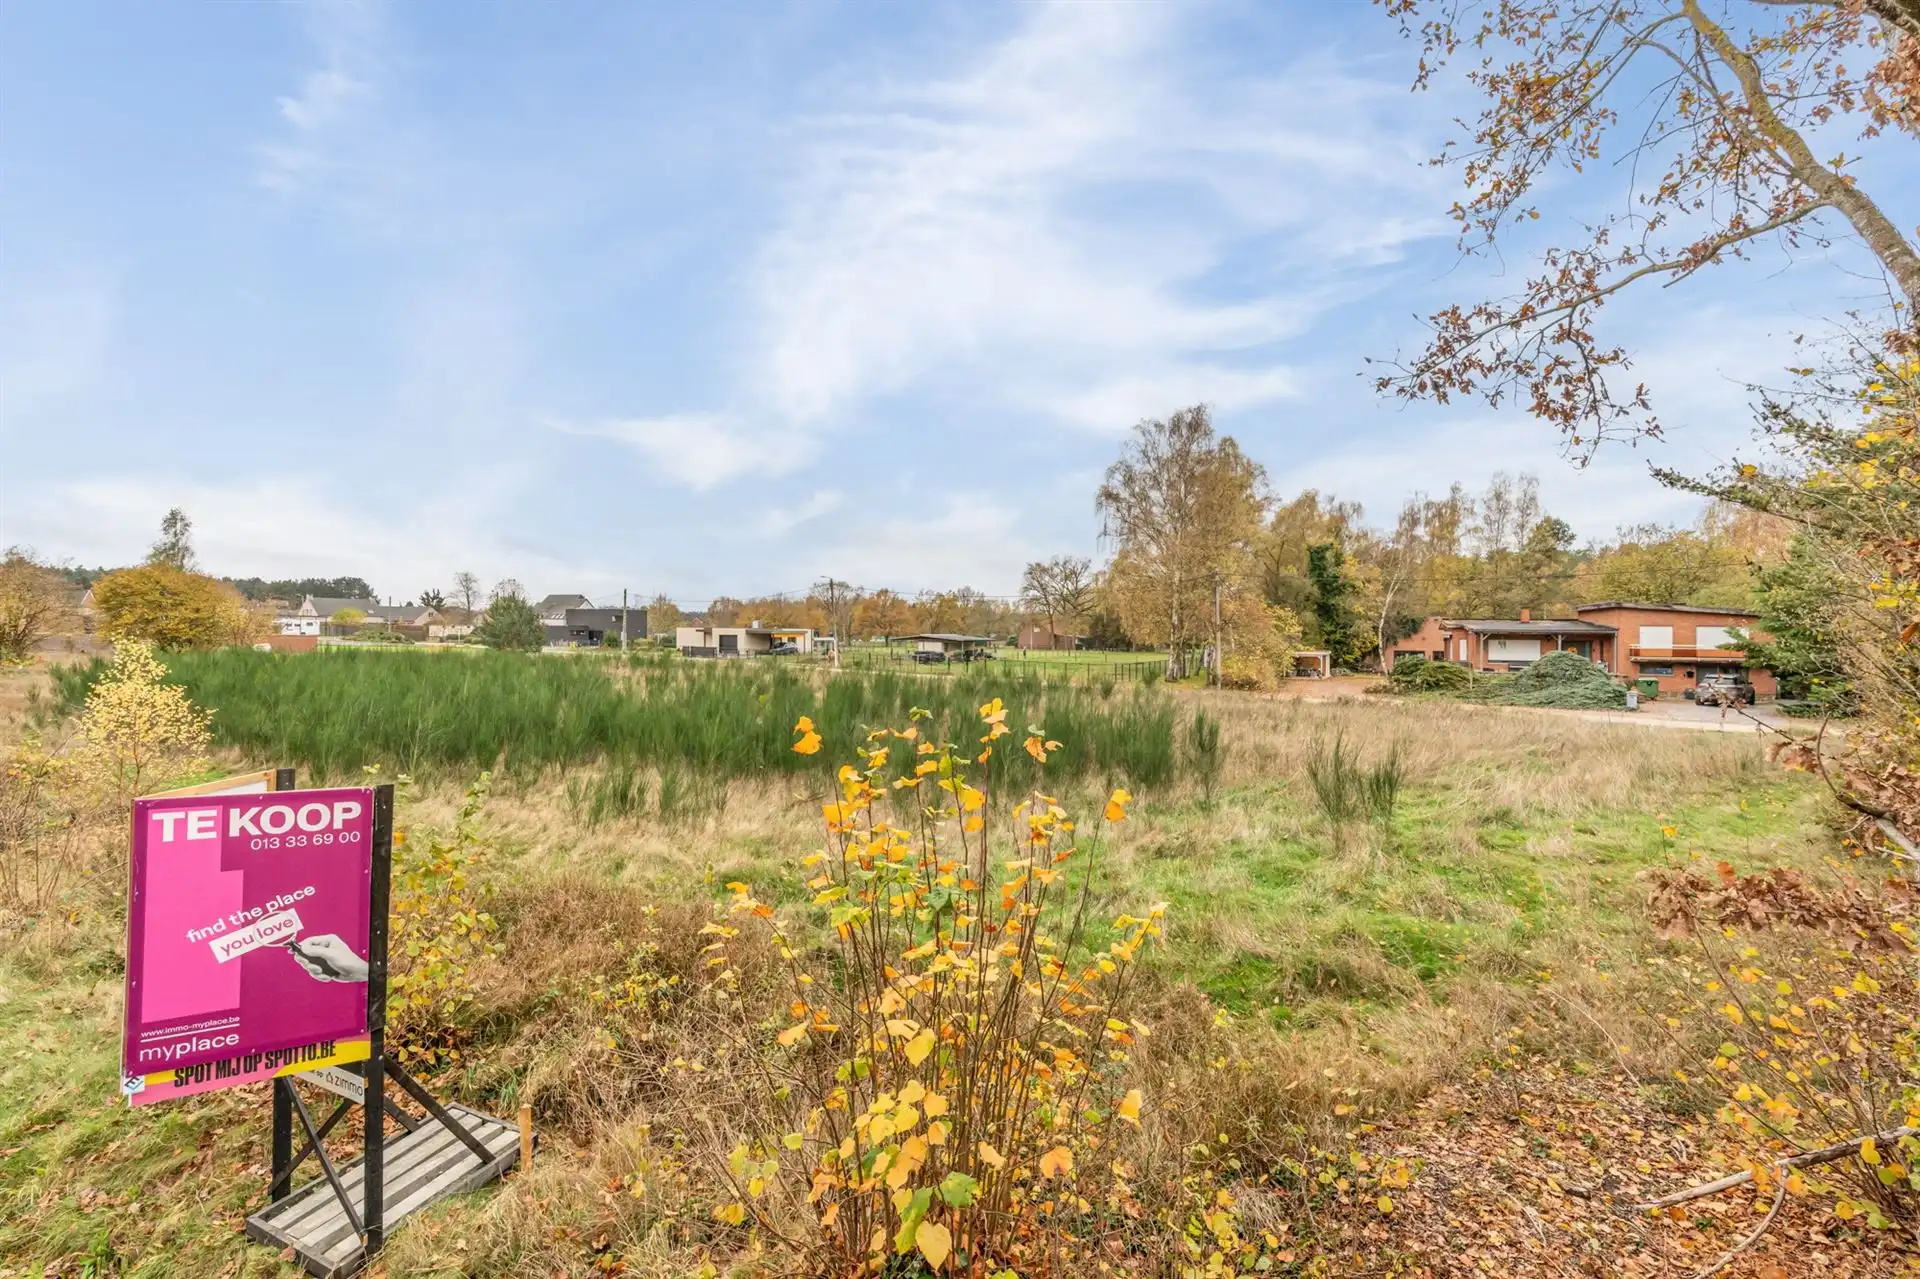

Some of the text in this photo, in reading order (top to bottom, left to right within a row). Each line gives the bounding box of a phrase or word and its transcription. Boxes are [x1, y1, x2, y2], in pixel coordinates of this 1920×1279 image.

[152, 802, 362, 842] TE KOOP
[250, 831, 361, 850] 013 33 69 00
[186, 886, 316, 943] find the place
[220, 918, 294, 957] you love
[140, 1016, 240, 1038] www.immo-myplace.be
[139, 1033, 240, 1062] myplace
[174, 1040, 336, 1087] SPOT MIJ OP SPOTTO.BE
[335, 1076, 363, 1096] zimmo
